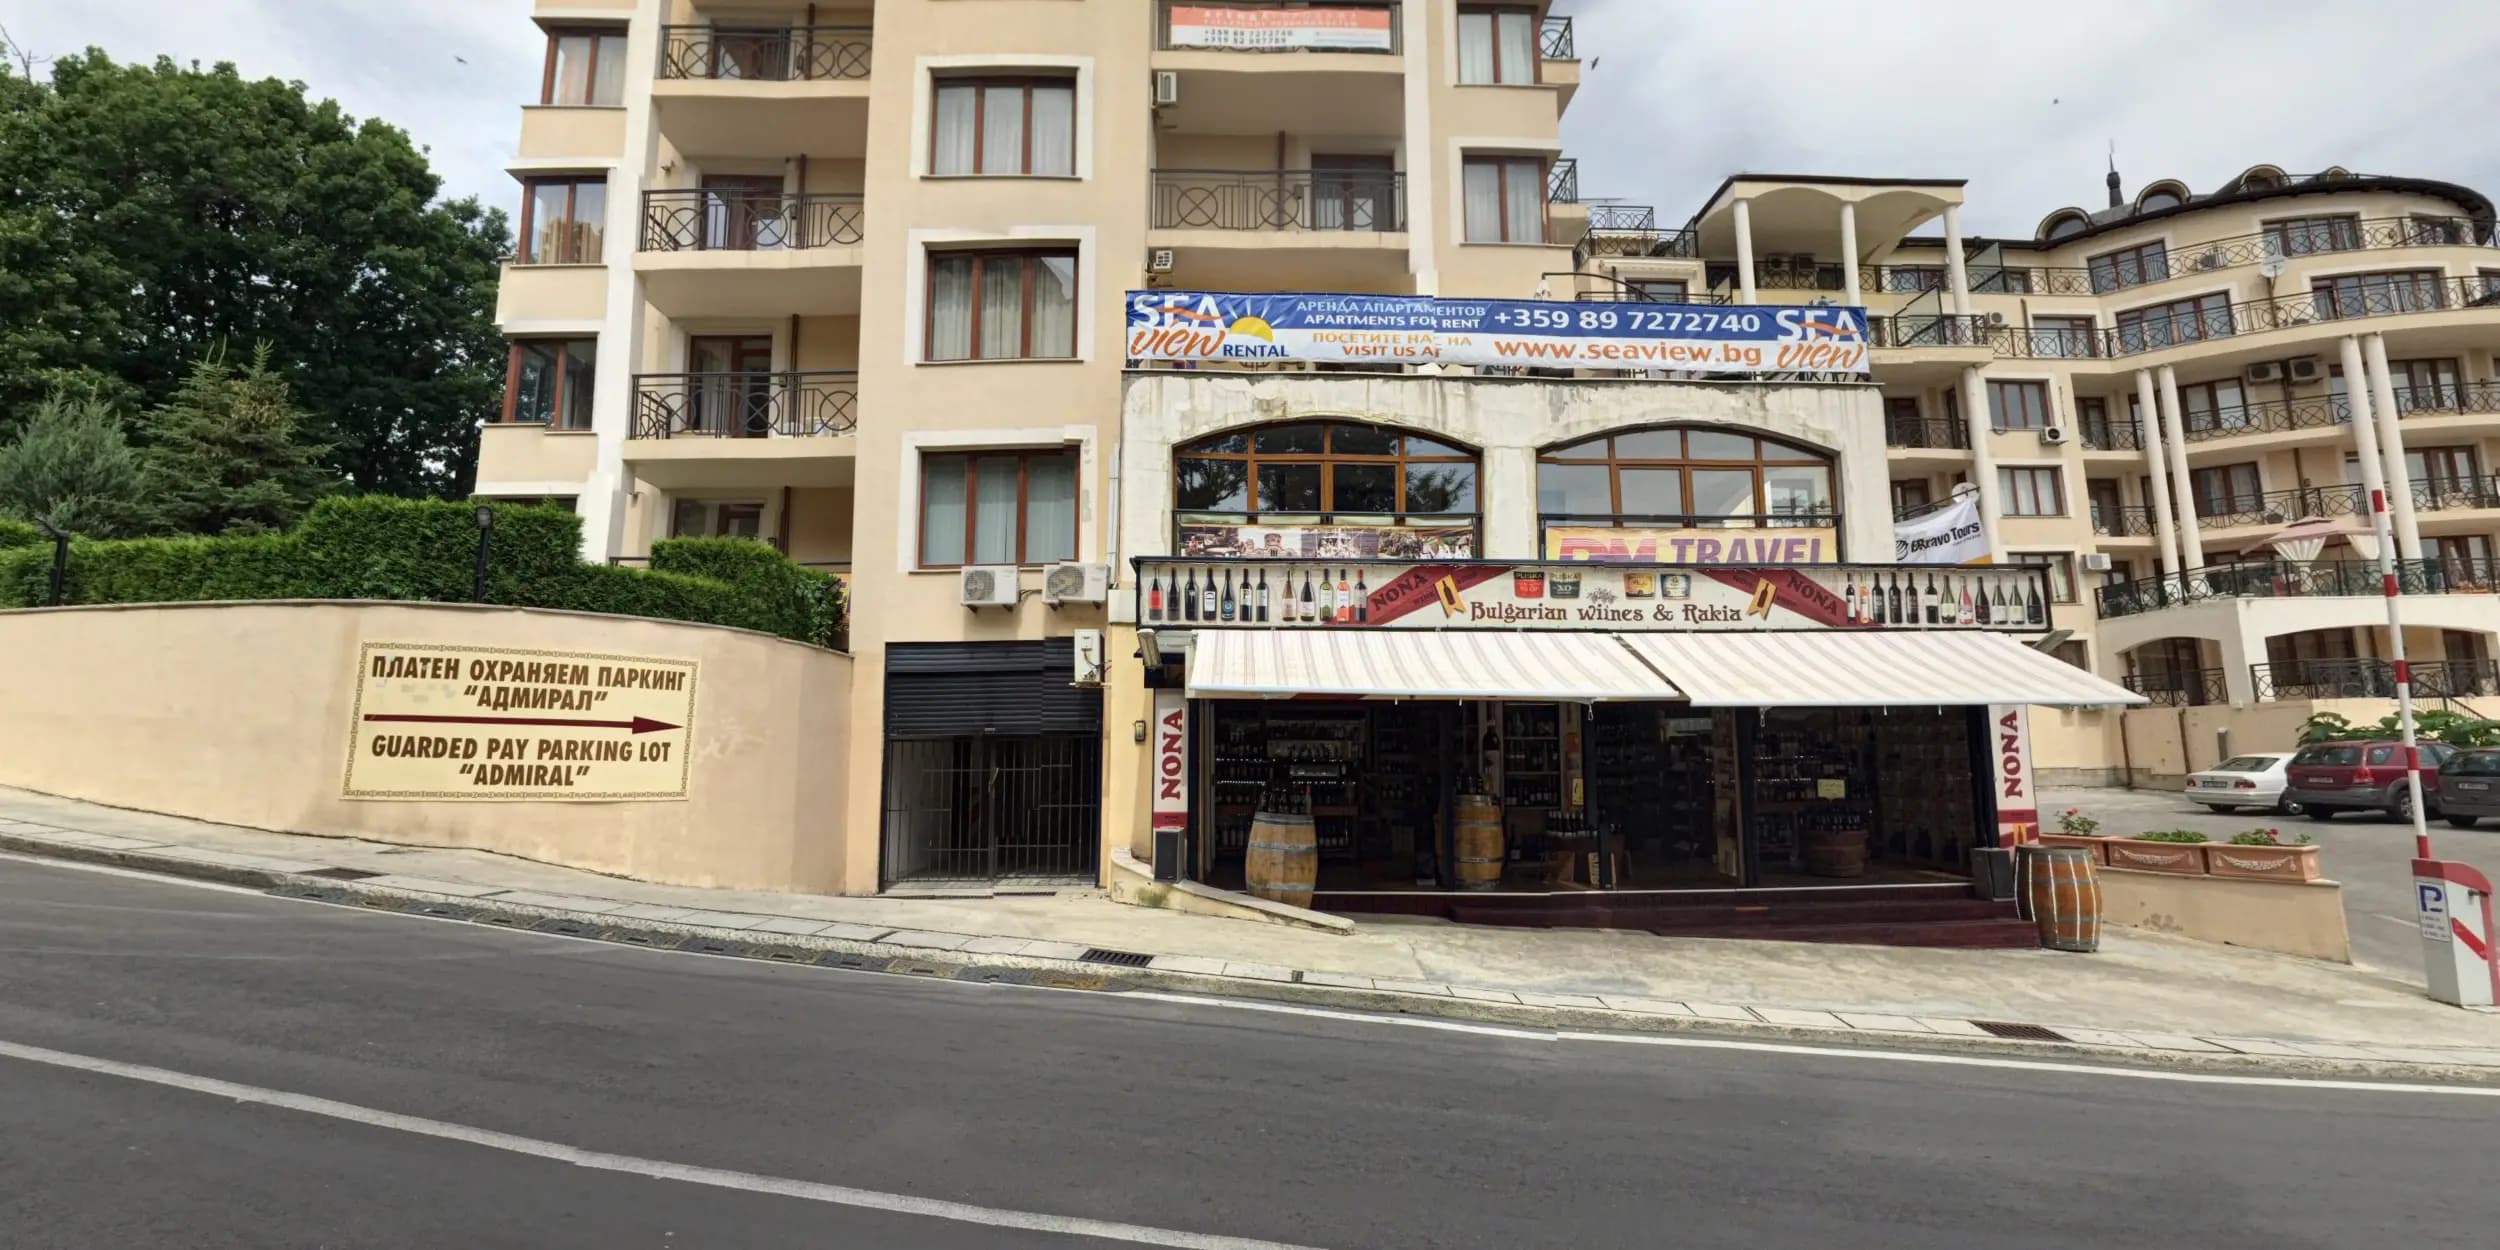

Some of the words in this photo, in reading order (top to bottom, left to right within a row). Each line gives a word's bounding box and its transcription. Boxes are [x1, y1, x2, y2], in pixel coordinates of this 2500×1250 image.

[1133, 294, 1226, 329] SEA
[1296, 301, 1360, 313] АРЕНДА
[1363, 302, 1486, 317] АПАРТАМЕНТОВ
[1304, 314, 1405, 326] APARTMENTS
[1442, 319, 1481, 329] RENT
[1494, 309, 1570, 329] +359
[1579, 310, 1618, 330] 89
[1627, 311, 1761, 333] 7272740
[1130, 319, 1226, 357] view
[1312, 332, 1401, 344] ПОСЕТИТЕ
[1775, 309, 1863, 341] SEA
[1223, 344, 1289, 358] RENTAL
[1342, 345, 1388, 356] VISIT
[1393, 346, 1416, 357] US
[1494, 341, 1761, 366] www.seaview.bg
[1776, 333, 1864, 369] view
[1370, 572, 1428, 612] NONA
[1787, 575, 1838, 616] NONA
[1470, 601, 1568, 624] Bulgarian
[1652, 603, 1674, 621] &
[1682, 604, 1743, 624] Rakia
[371, 655, 461, 681] ПЛАТЕН
[469, 659, 590, 687] ОХРАНЯЕМ
[598, 665, 687, 692] ПАРКИНГ
[371, 735, 479, 760] GUARDED
[486, 738, 530, 761] PAY
[537, 739, 634, 763] PARKING
[639, 741, 672, 763] LOT
[1161, 708, 1184, 801] NONA
[2000, 709, 2023, 799] NONA
